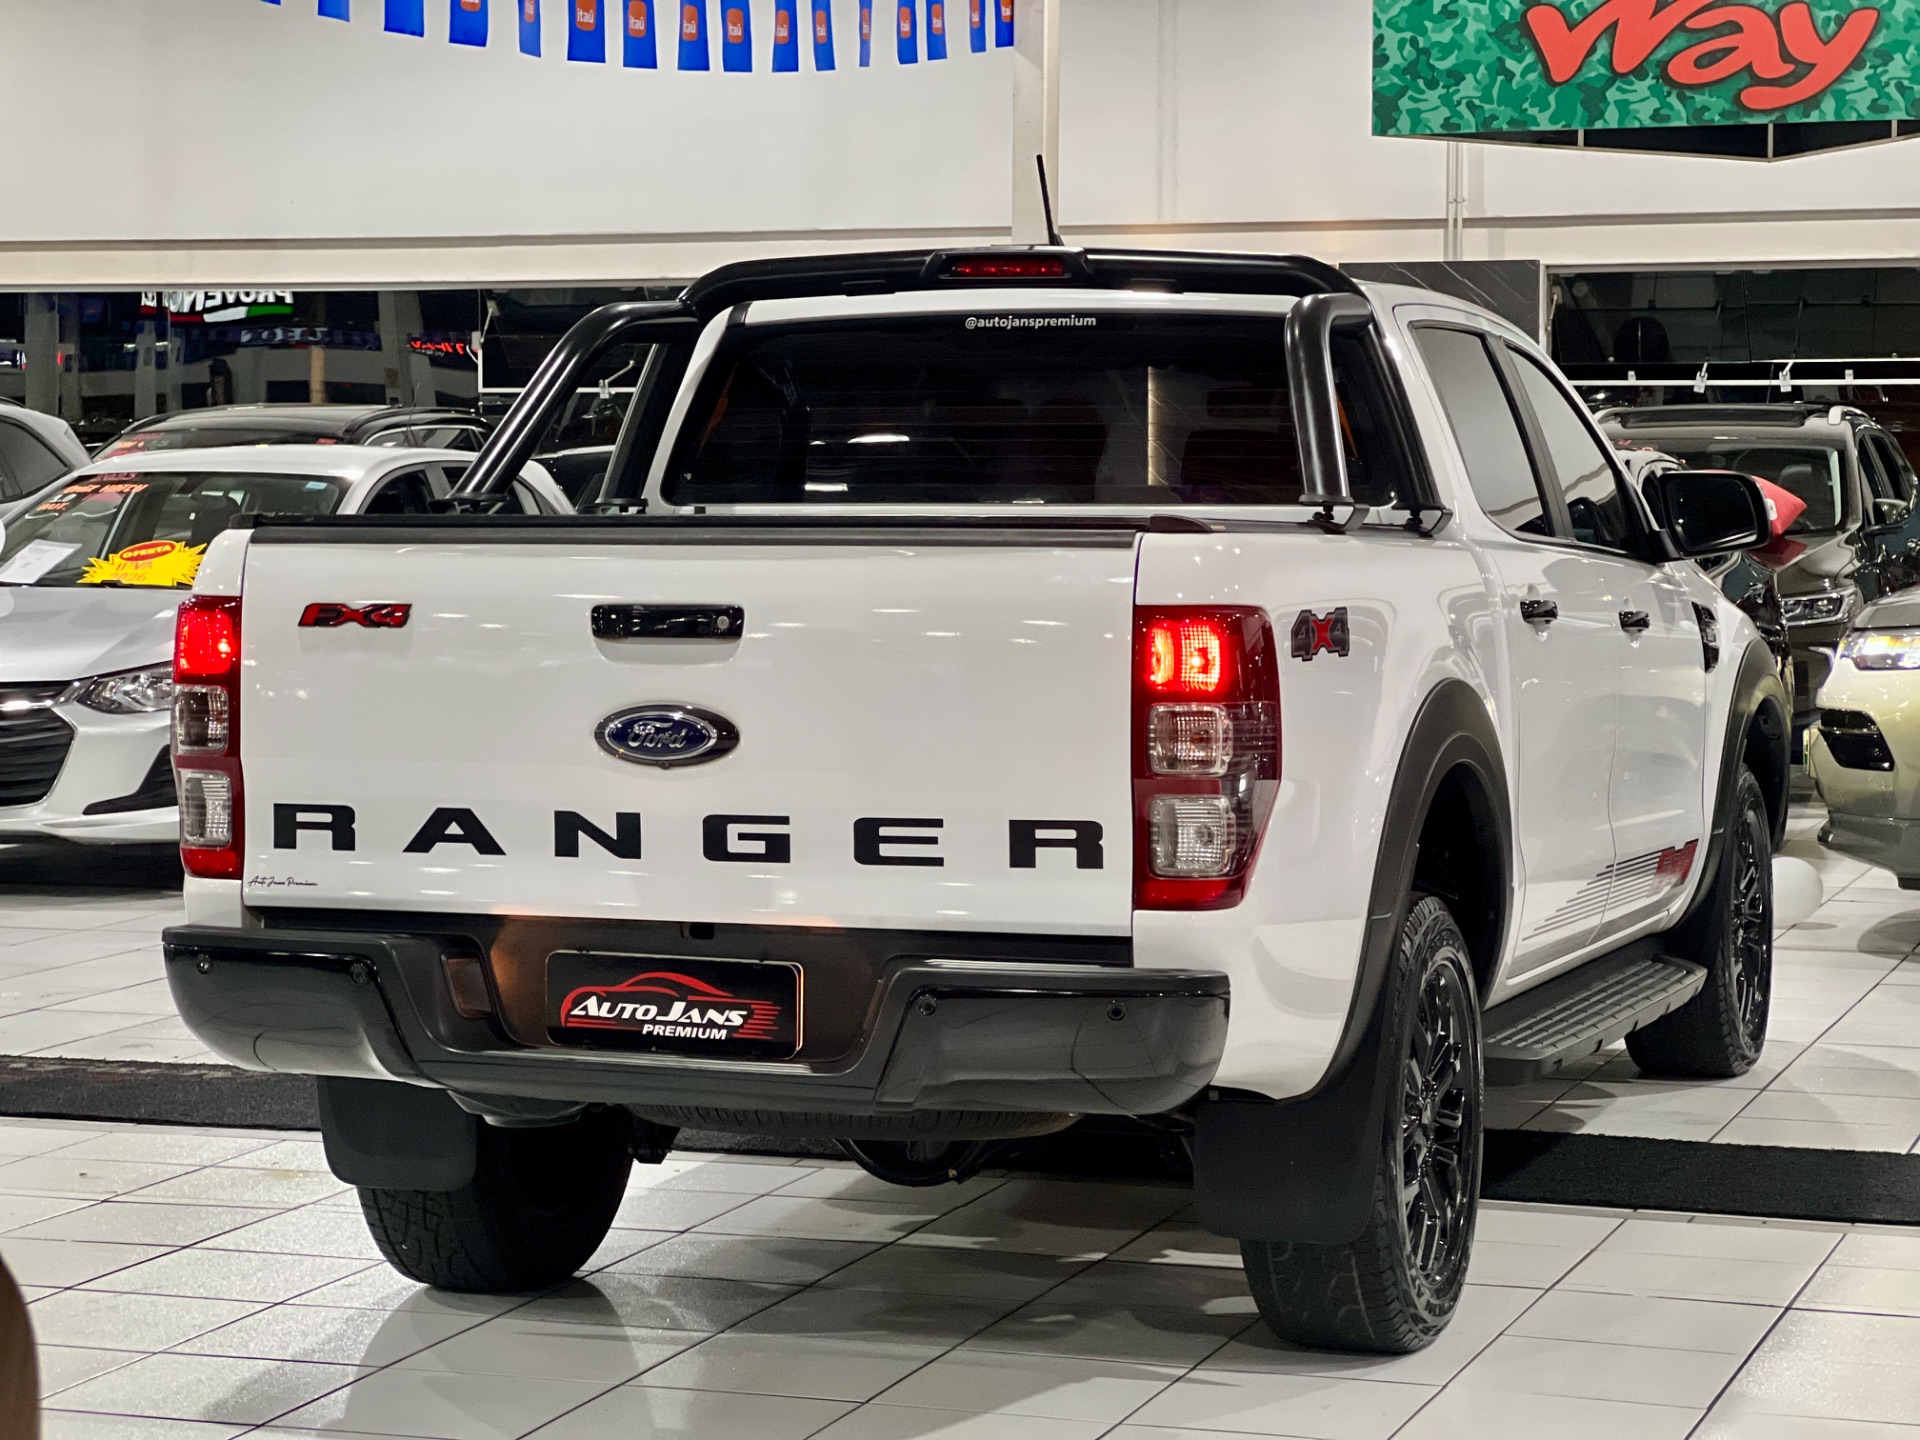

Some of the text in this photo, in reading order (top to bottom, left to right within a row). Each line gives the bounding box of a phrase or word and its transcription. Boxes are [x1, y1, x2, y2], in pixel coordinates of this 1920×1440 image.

[965, 314, 1097, 329] @autojanspremium
[121, 544, 172, 559] OFERTA
[627, 720, 688, 748] Ford
[273, 802, 1104, 870] RANGER
[642, 1024, 727, 1040] PREMIUM
